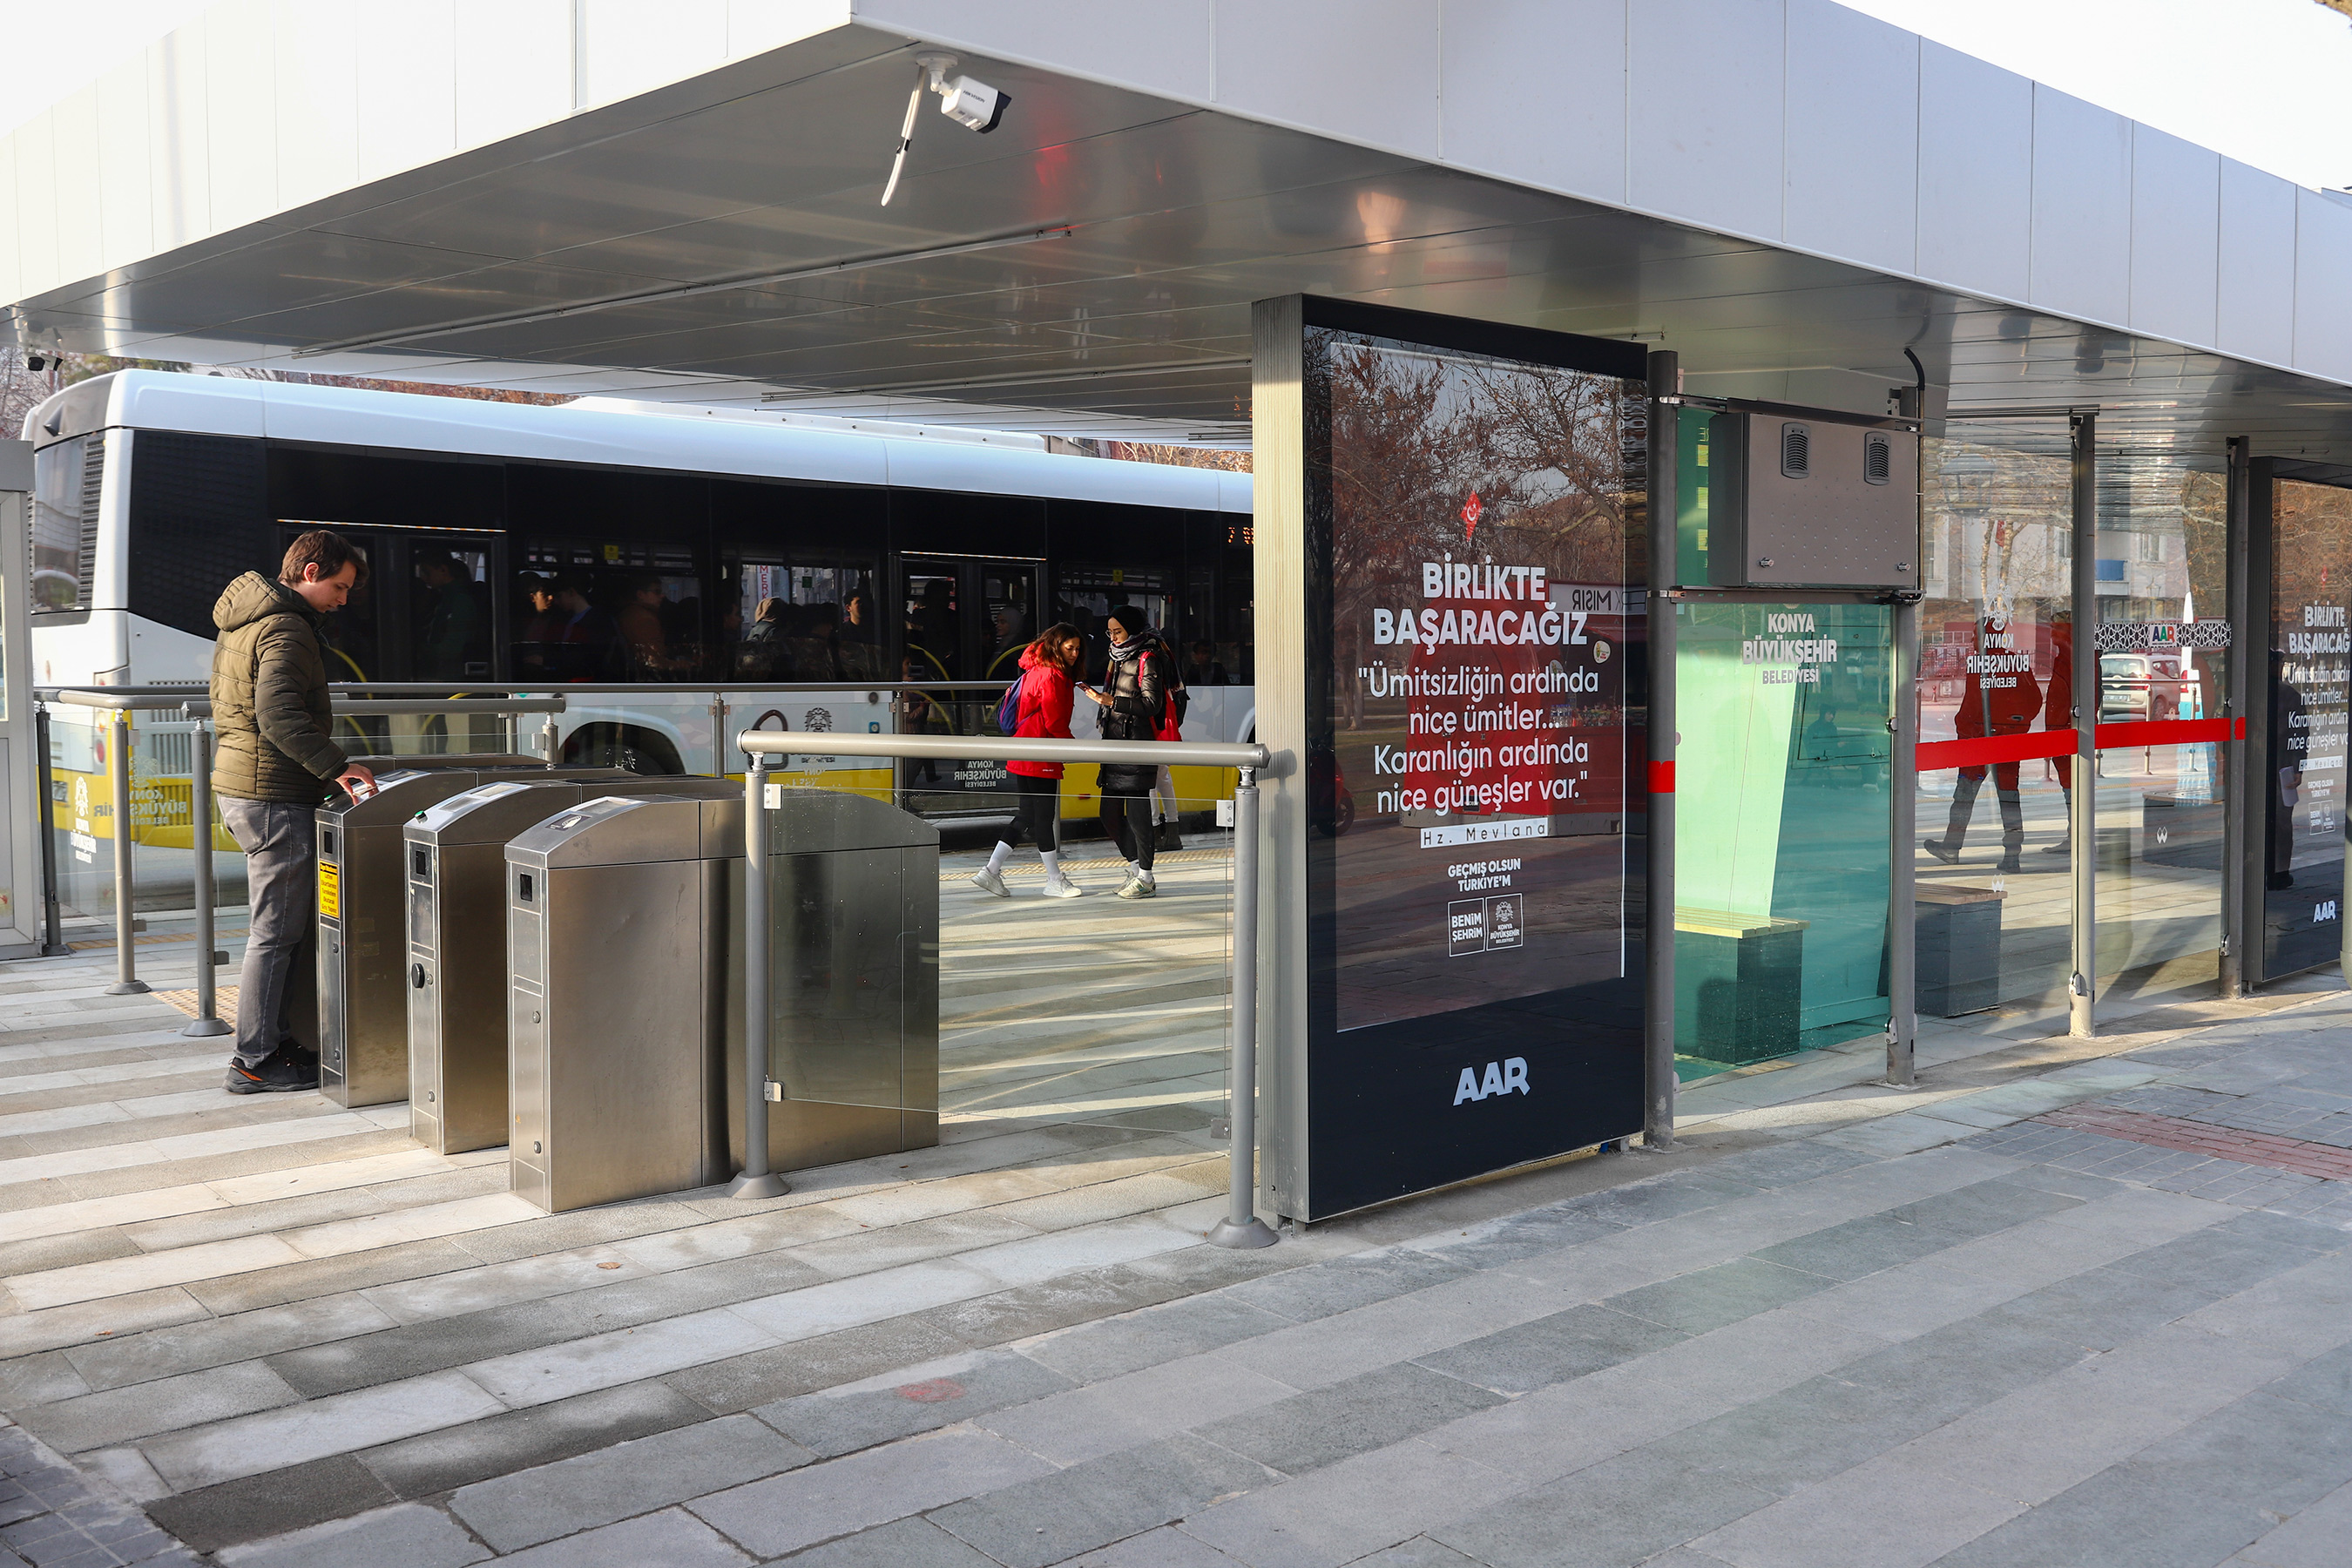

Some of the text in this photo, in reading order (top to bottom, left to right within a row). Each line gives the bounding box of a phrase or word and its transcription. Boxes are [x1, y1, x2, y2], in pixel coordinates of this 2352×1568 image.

[1423, 551, 1545, 601] BİRLİKTE
[1768, 613, 1815, 632] KONYA
[2305, 600, 2345, 626] BİRLİKTE
[1374, 602, 1587, 654] BAŞARACAĞIZ
[2152, 625, 2175, 643] AAR
[1743, 635, 1837, 666] BÜYÜKŞEHİR
[2288, 627, 2350, 659] BAŞARACAĞ
[1358, 660, 1599, 702] "Ümitsizliğin ardında
[1762, 666, 1819, 685] BELEDİYESİ
[2301, 688, 2317, 706] nice
[1409, 702, 1559, 734] nice ümitler...
[2328, 708, 2348, 725] ardın
[2288, 733, 2305, 750] nice
[1375, 737, 1588, 776] Karanlığın ardında
[1377, 770, 1588, 815] nice güneşler var."
[1423, 824, 1545, 846] Hz. Mevlana
[1448, 858, 1521, 879] GEÇMİŞ OLSUN
[1458, 875, 1511, 892] TÜRKİYE'M
[1451, 913, 1482, 928] BENİM
[2313, 900, 2336, 923] AAR
[1452, 927, 1483, 943] ŞEHRİM
[1453, 1056, 1531, 1106] AAR
